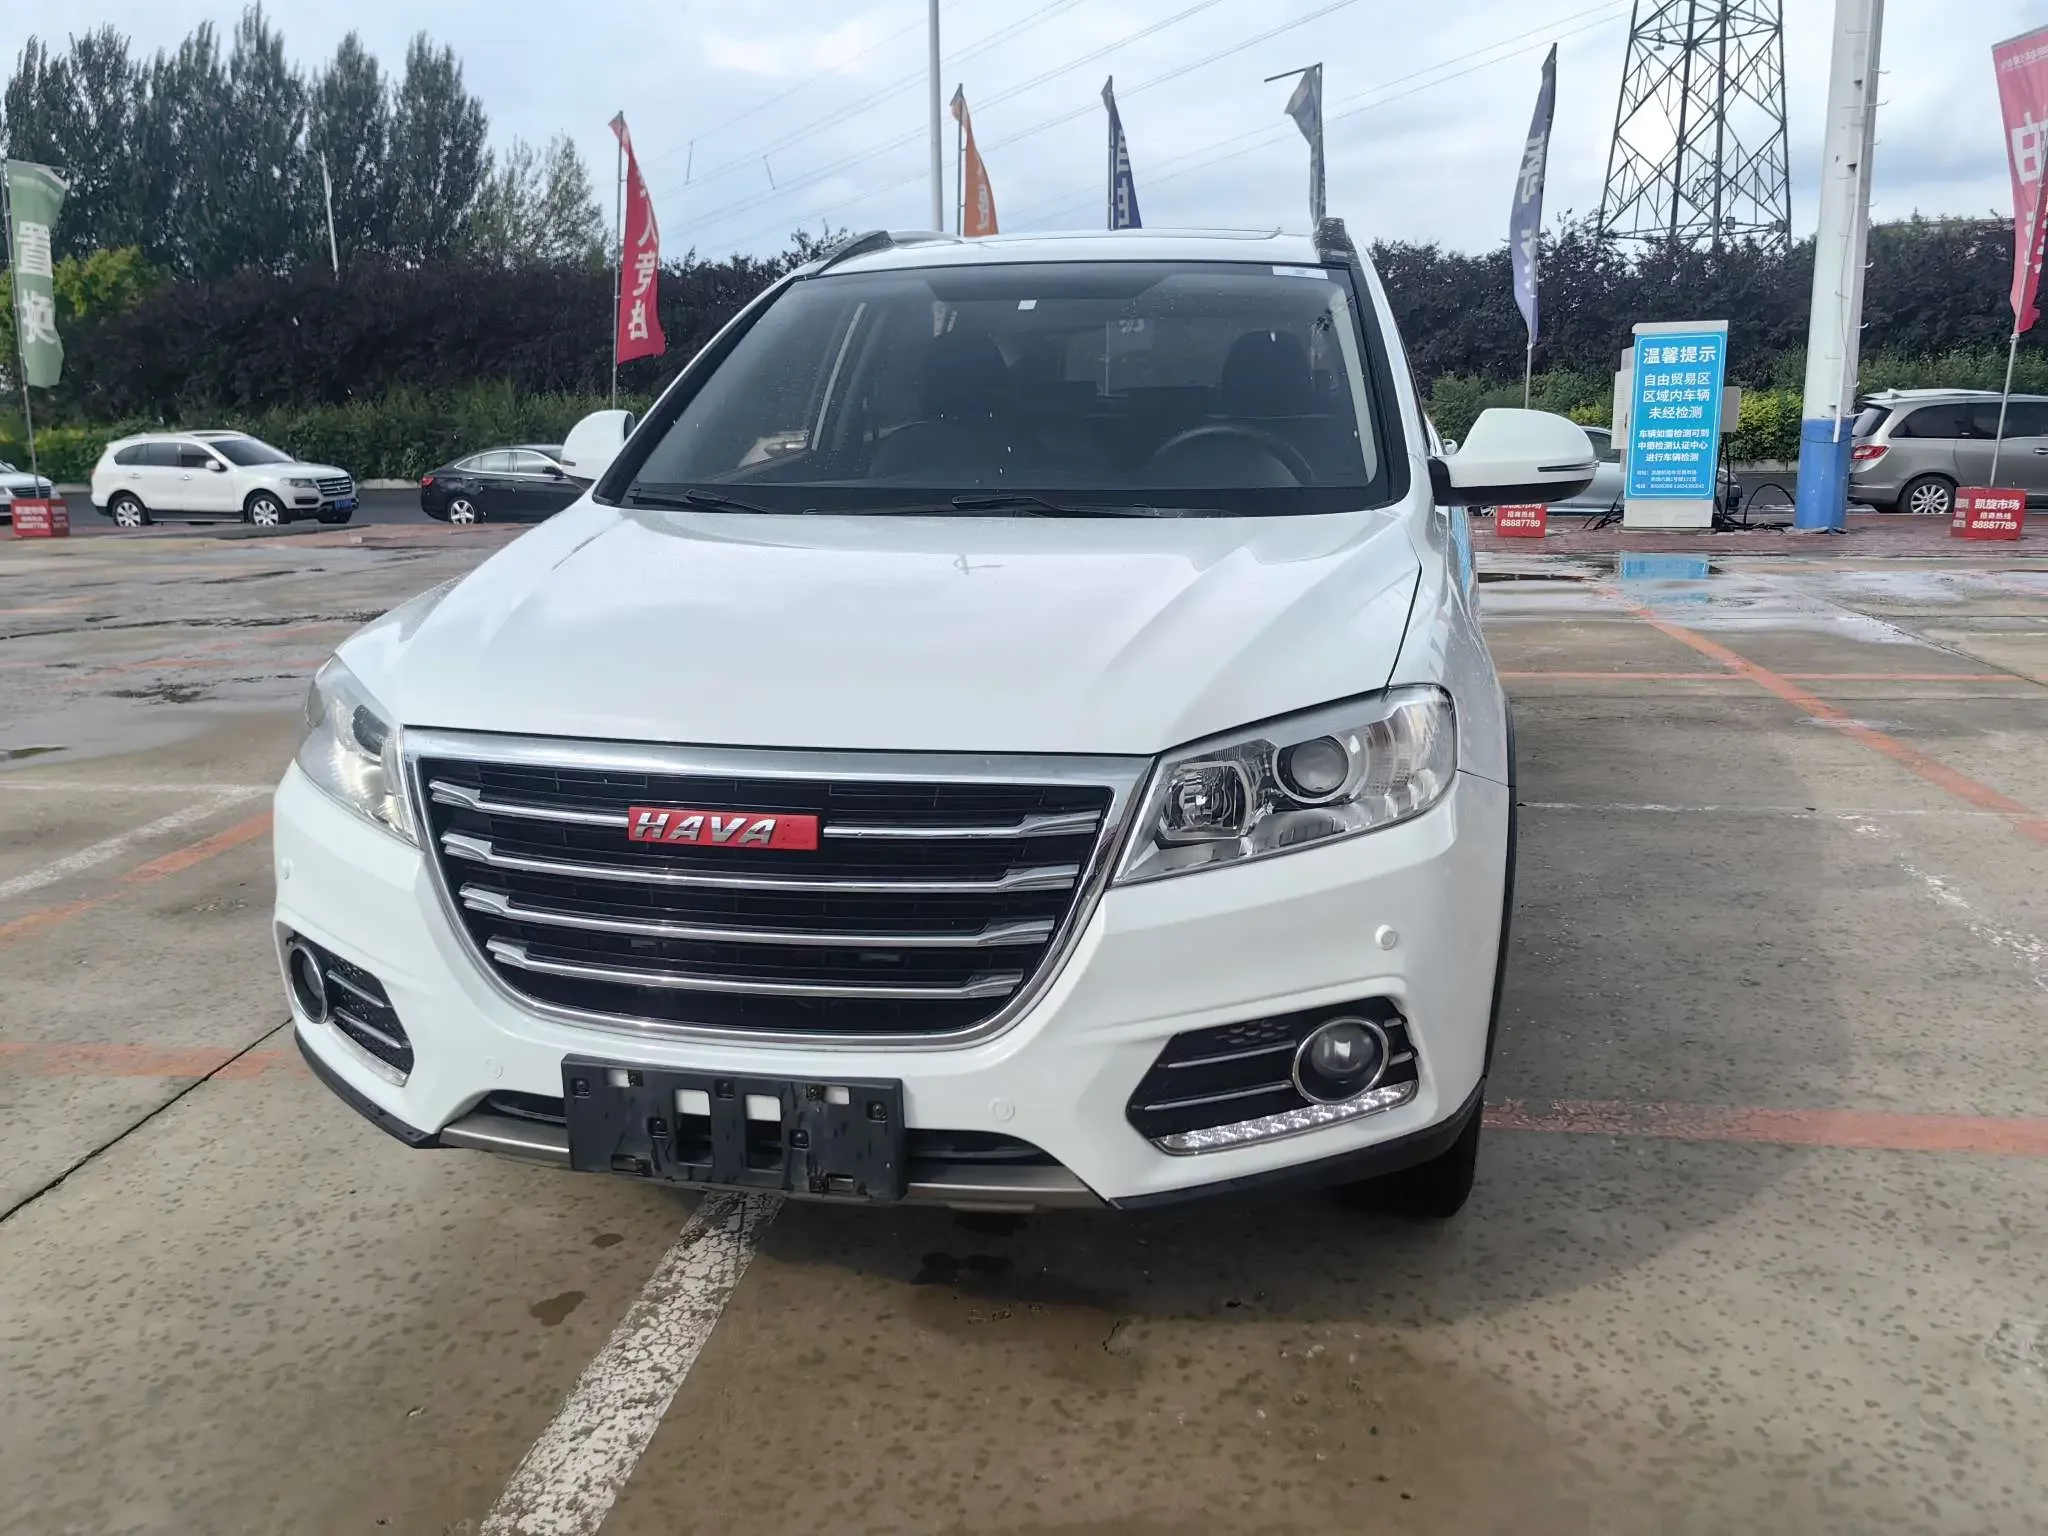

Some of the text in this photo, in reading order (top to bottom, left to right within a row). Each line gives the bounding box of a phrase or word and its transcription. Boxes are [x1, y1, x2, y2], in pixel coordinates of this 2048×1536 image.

[1643, 346, 1716, 364] 温馨提示
[1644, 372, 1711, 387] 自由贸易区
[1643, 388, 1710, 403] 区域内车辆
[1648, 406, 1703, 420] 未经检测
[1501, 519, 1540, 527] 88887789
[1972, 520, 2017, 530] 88887789
[634, 812, 777, 845] HAVA
